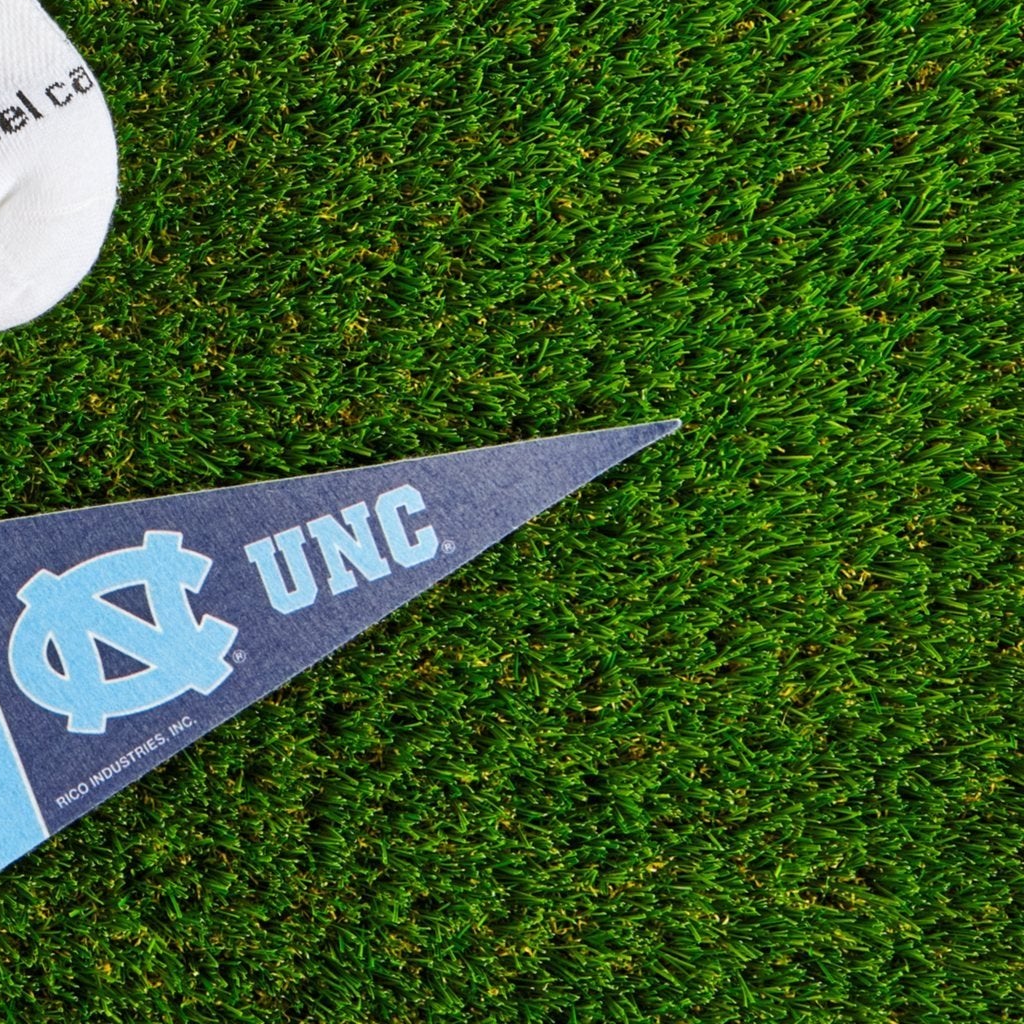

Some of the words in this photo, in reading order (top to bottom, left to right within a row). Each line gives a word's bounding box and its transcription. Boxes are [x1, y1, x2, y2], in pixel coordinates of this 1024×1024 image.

[244, 484, 440, 615] UNC
[56, 782, 89, 809] RICO
[89, 733, 170, 787] INDUSTRIES,
[168, 715, 197, 736] INC.
